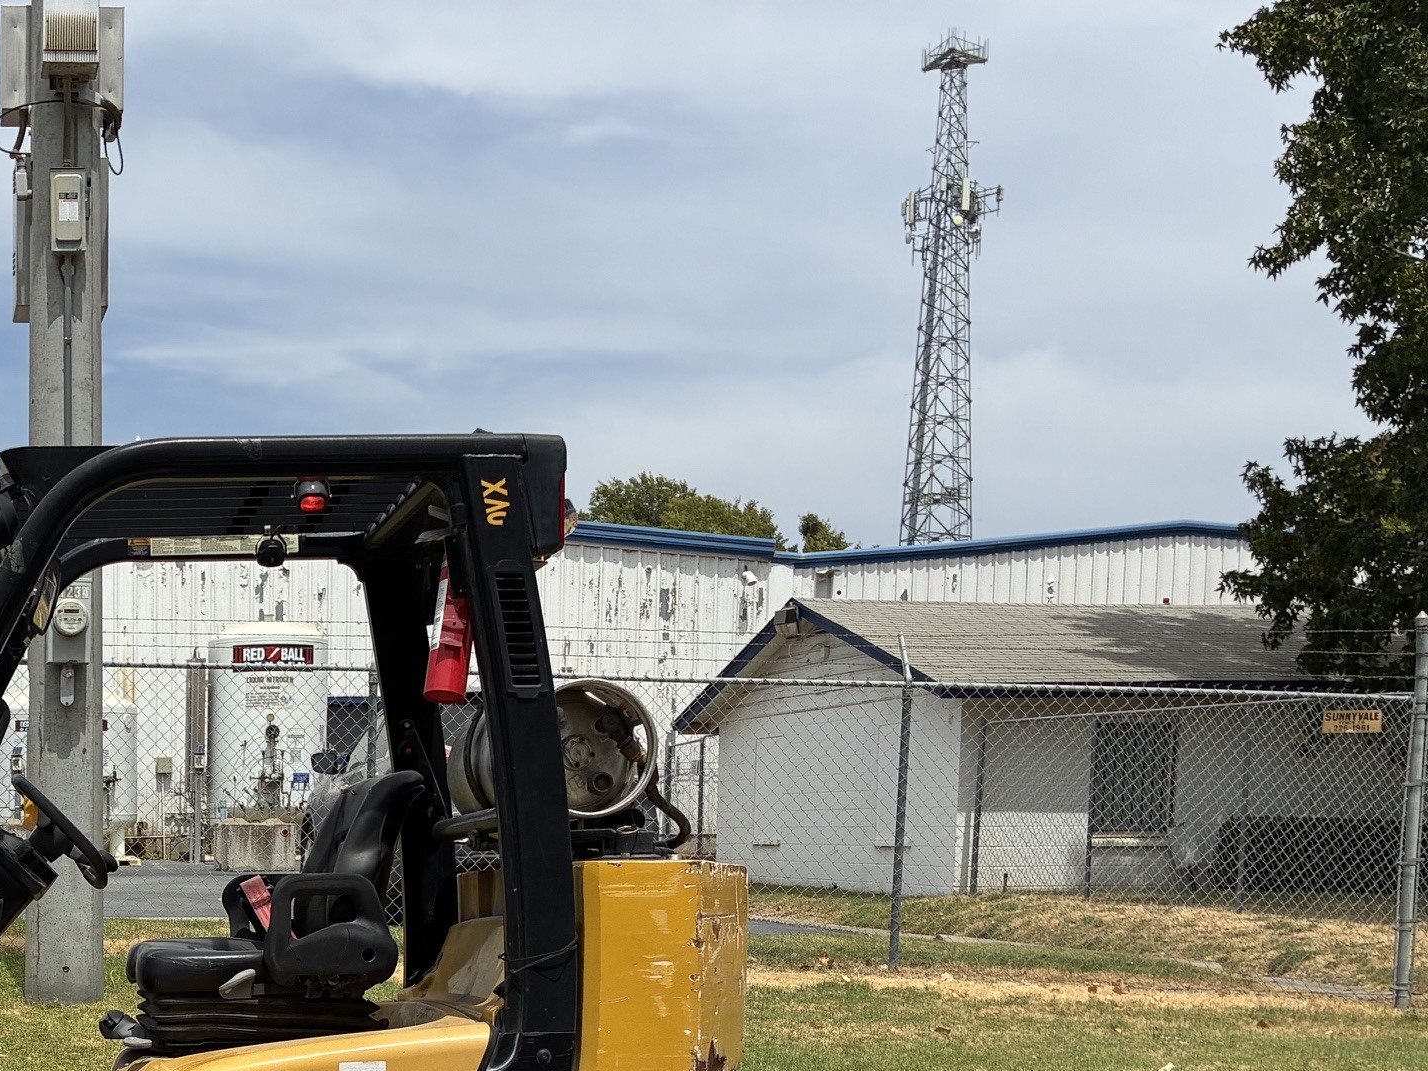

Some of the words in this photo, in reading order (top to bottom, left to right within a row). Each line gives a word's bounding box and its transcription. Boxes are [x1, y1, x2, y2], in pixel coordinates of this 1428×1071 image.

[243, 647, 266, 662] RED
[280, 647, 306, 662] BALL
[266, 676, 294, 684] NITROGEN
[1325, 712, 1380, 721] SUNNYVALE
